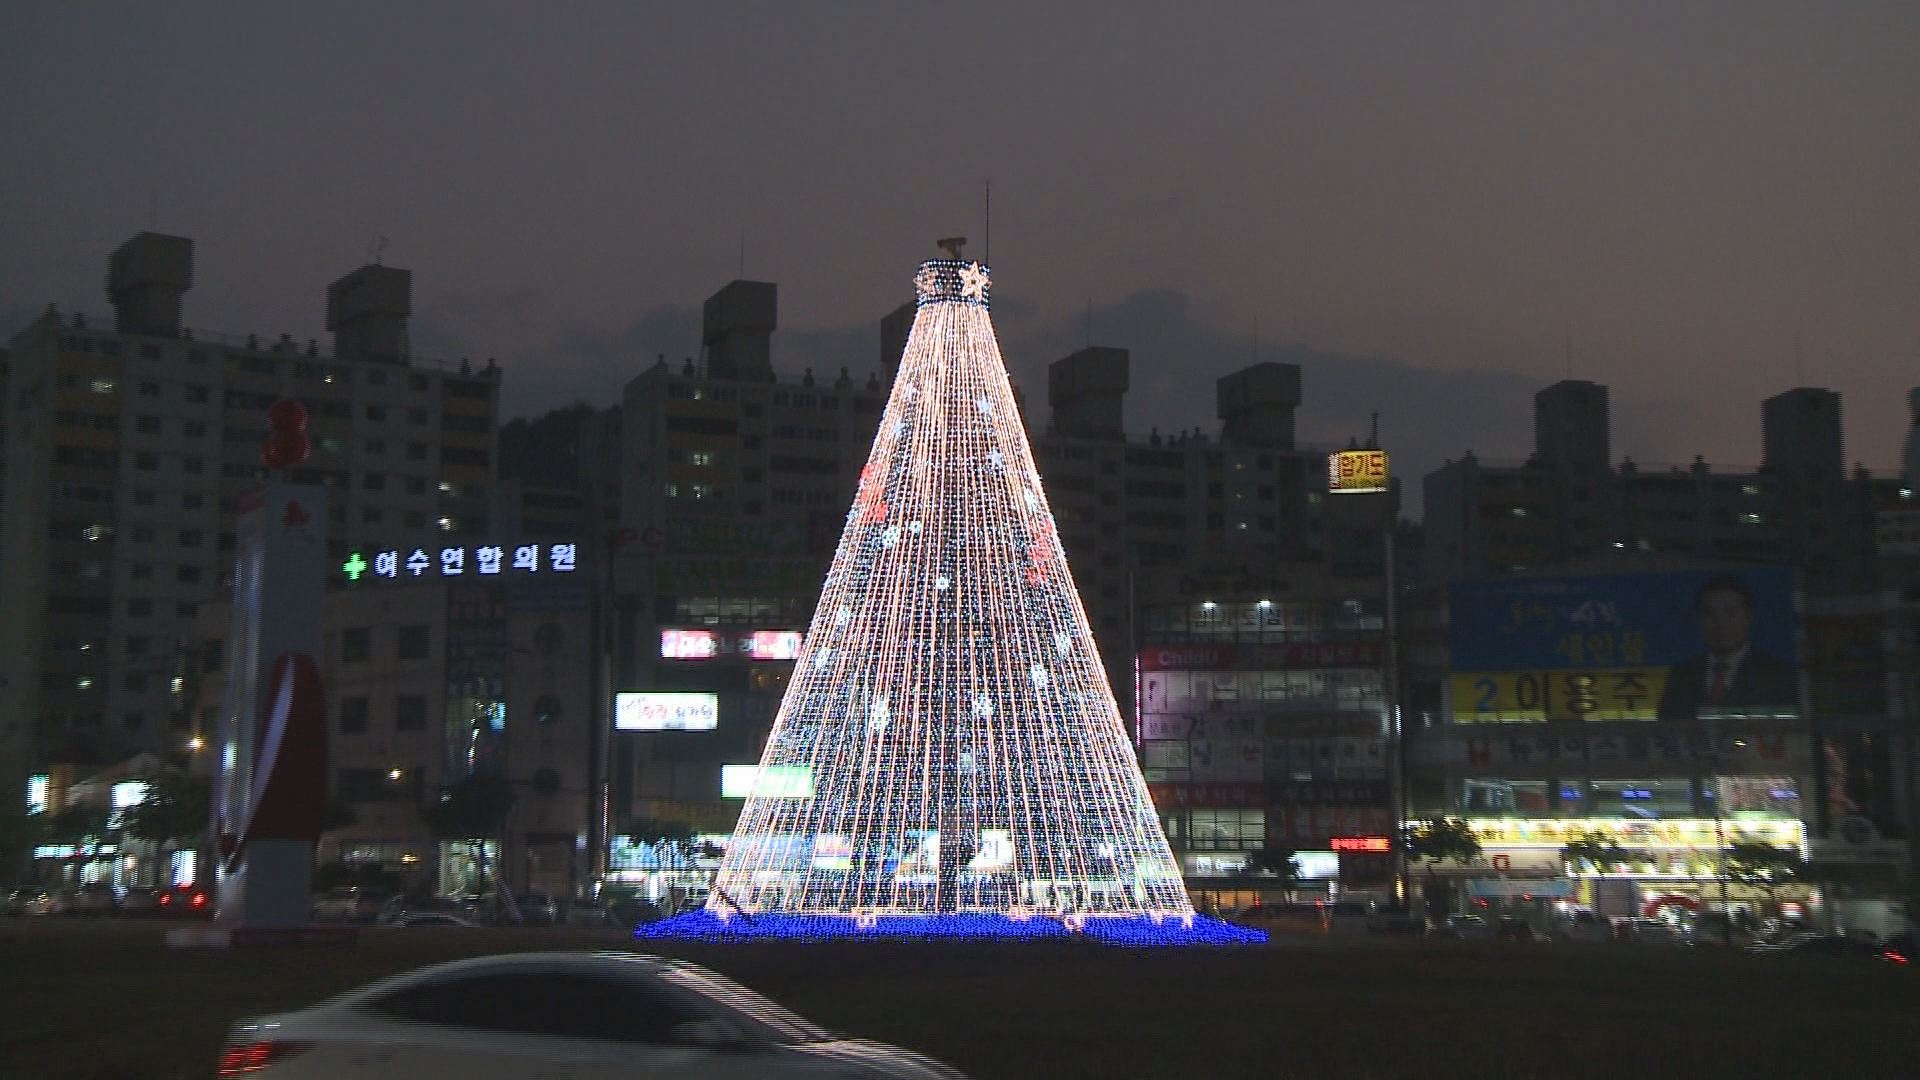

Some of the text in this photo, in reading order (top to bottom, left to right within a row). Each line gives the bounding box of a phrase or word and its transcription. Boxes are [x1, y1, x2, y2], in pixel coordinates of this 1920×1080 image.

[1342, 454, 1384, 477] 합기도
[374, 543, 577, 578] 여수연합의원
[1473, 672, 1649, 714] 2 이용주
